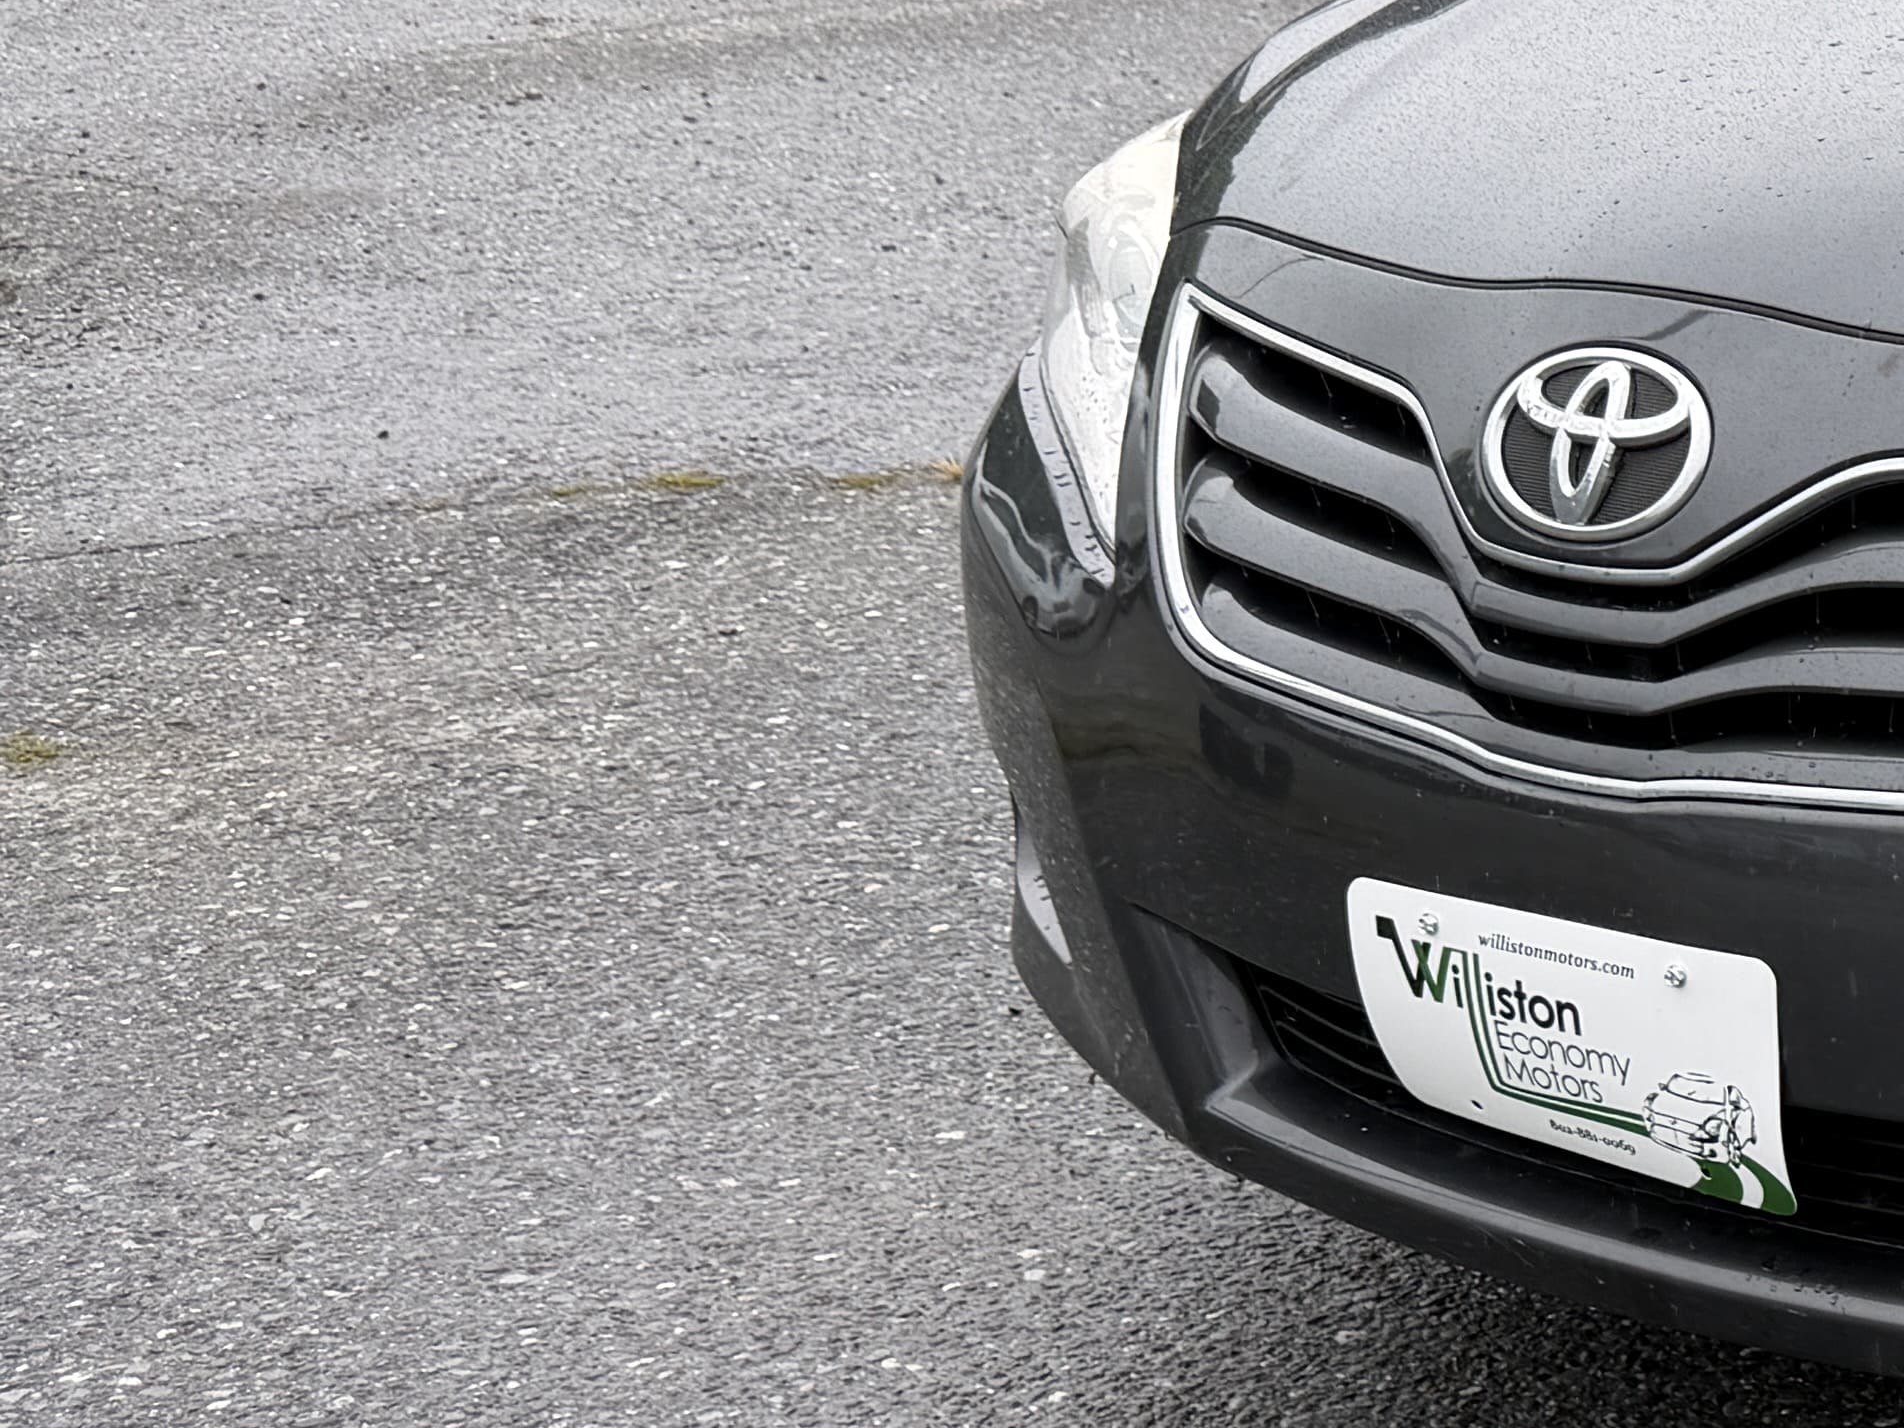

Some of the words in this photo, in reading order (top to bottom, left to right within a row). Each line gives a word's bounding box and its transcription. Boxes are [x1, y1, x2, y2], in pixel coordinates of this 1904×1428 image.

[1375, 914, 1582, 1036] Williston
[1478, 932, 1635, 979] willistonmotors.com
[1494, 1019, 1631, 1086] Economy
[1503, 1054, 1604, 1104] Motors
